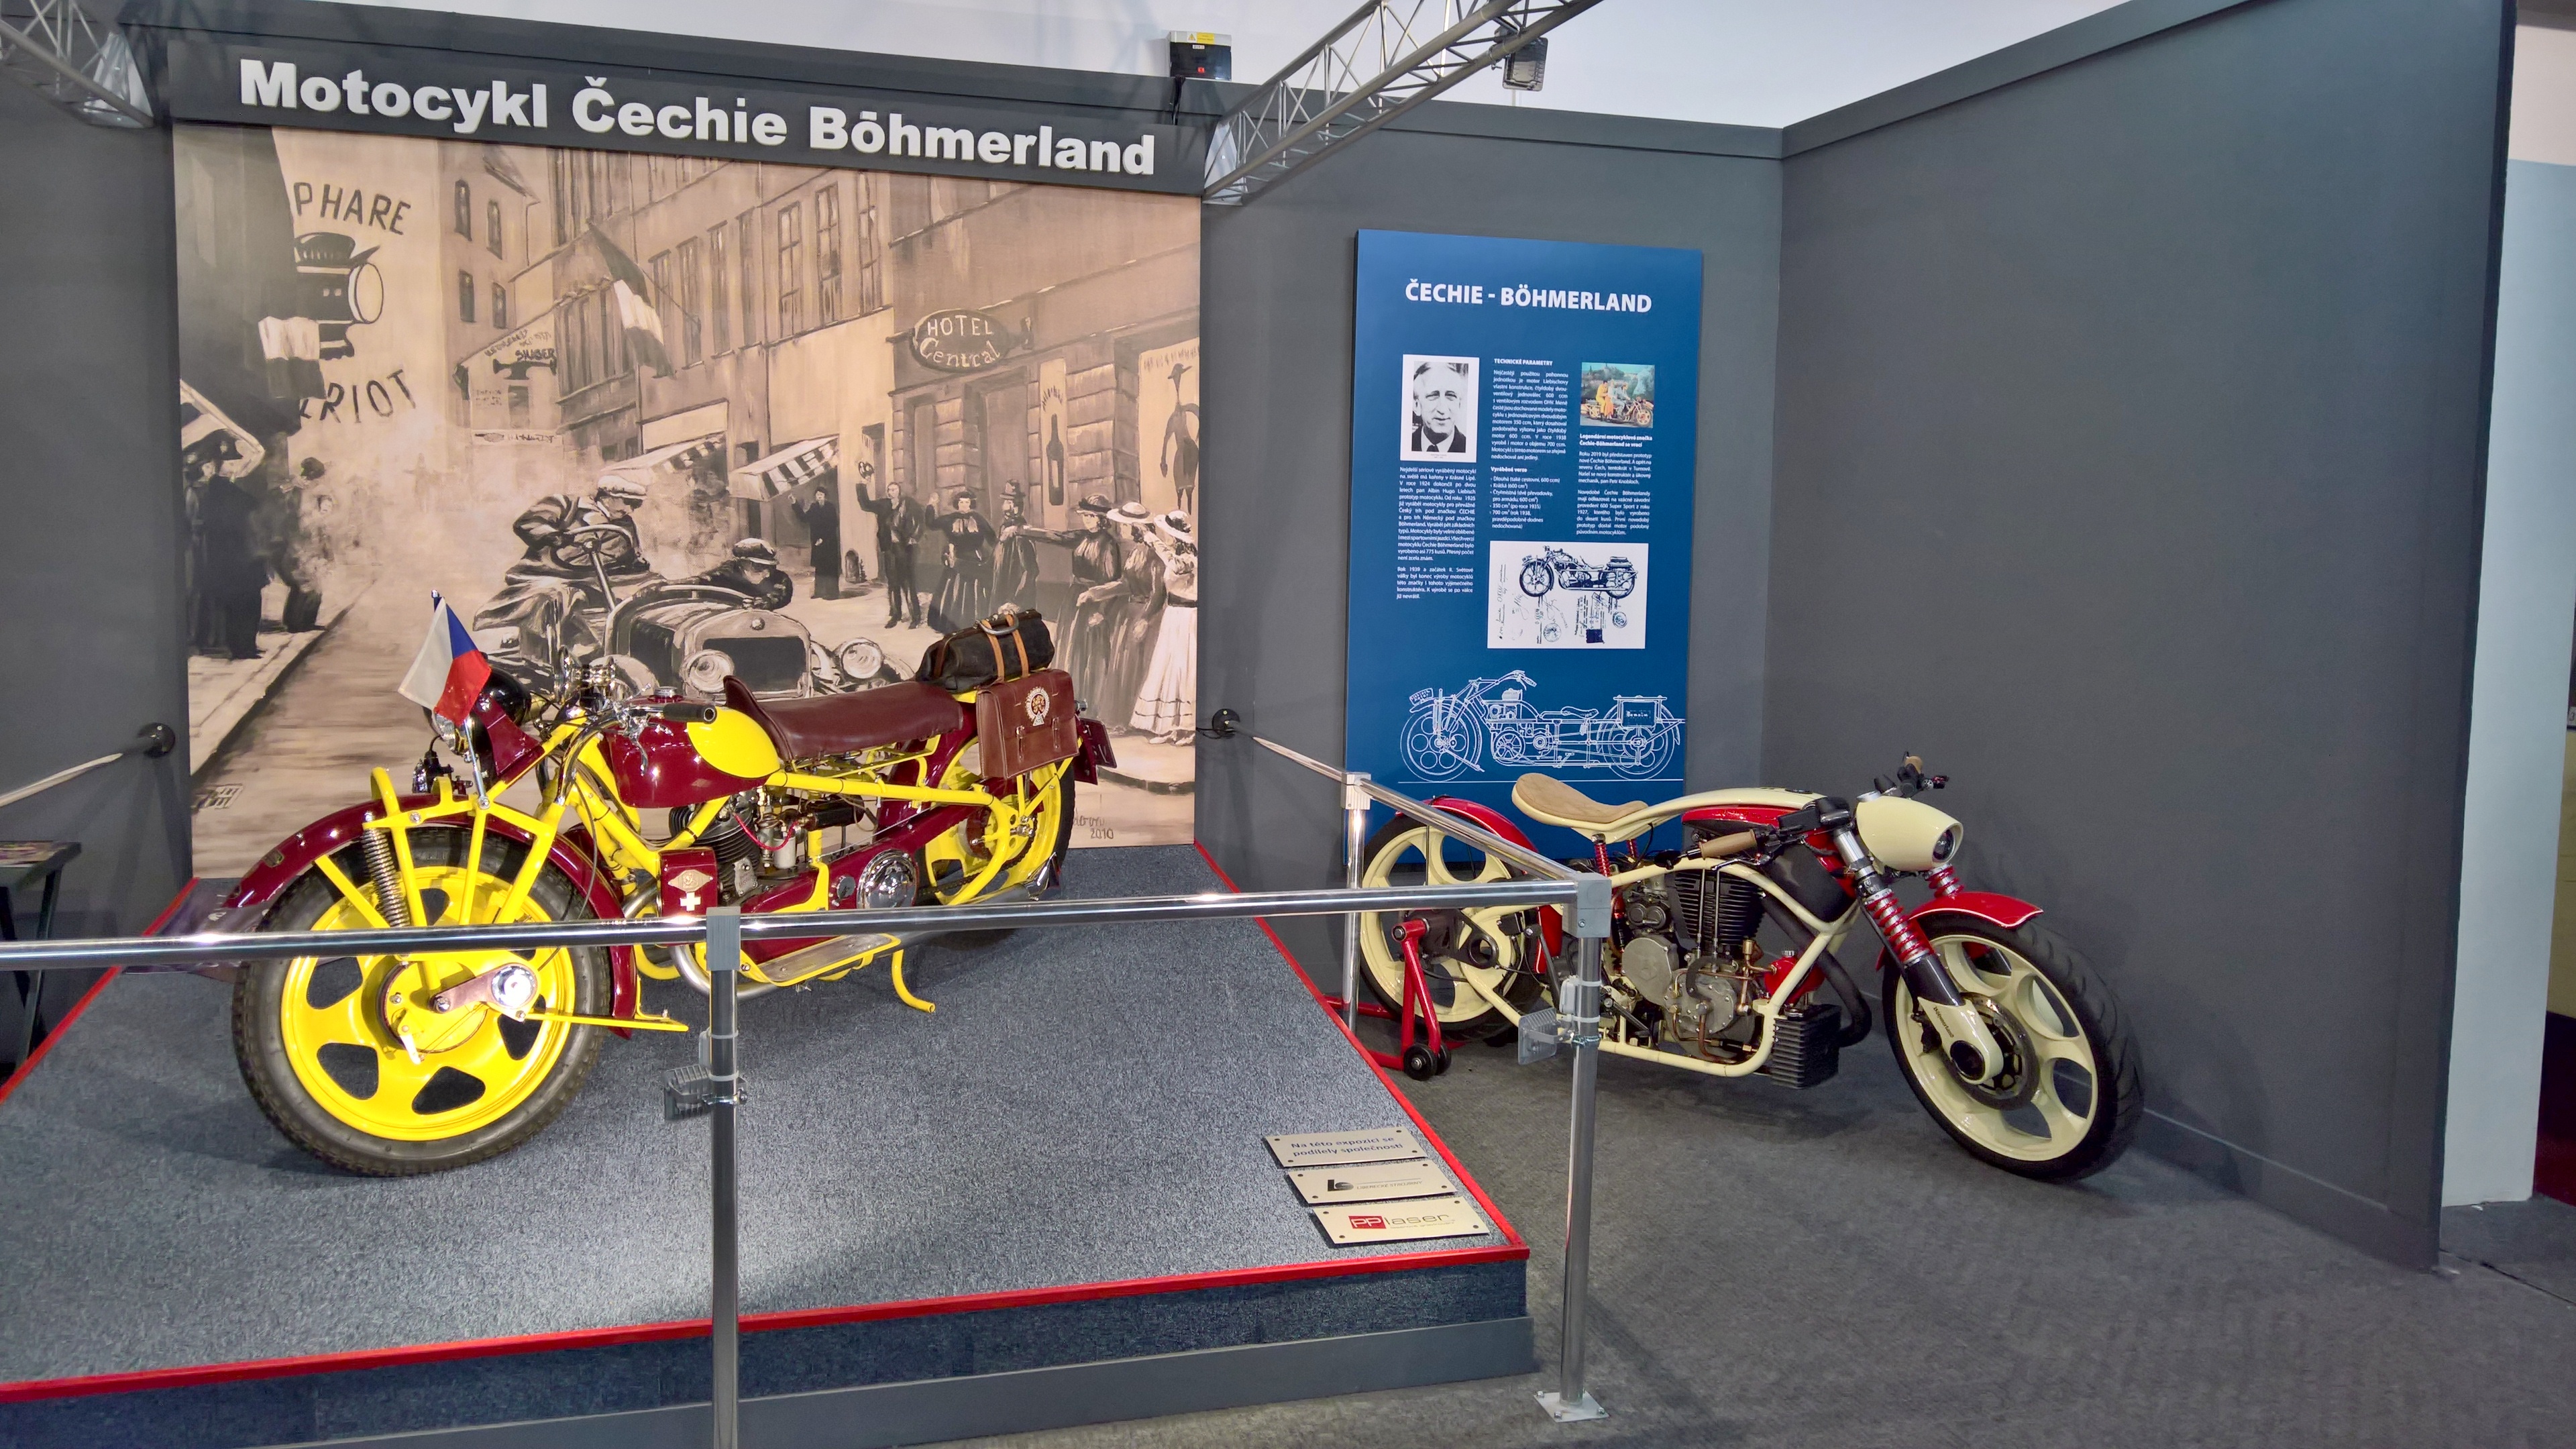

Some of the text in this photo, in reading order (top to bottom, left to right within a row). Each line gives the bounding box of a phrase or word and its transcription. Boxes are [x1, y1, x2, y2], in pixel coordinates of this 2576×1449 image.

[240, 58, 548, 134] Motocykl
[572, 76, 788, 146] Čechie
[293, 182, 411, 235] PHARE
[1405, 278, 1483, 305] ČECHIE
[1501, 284, 1652, 313] BÖHMERLAND
[927, 315, 994, 337] HOTEL
[920, 337, 1000, 368] Central
[1090, 828, 1114, 839] 2010
[1293, 1143, 1403, 1157] podílely společnosti
[1336, 1138, 1379, 1146] expozici
